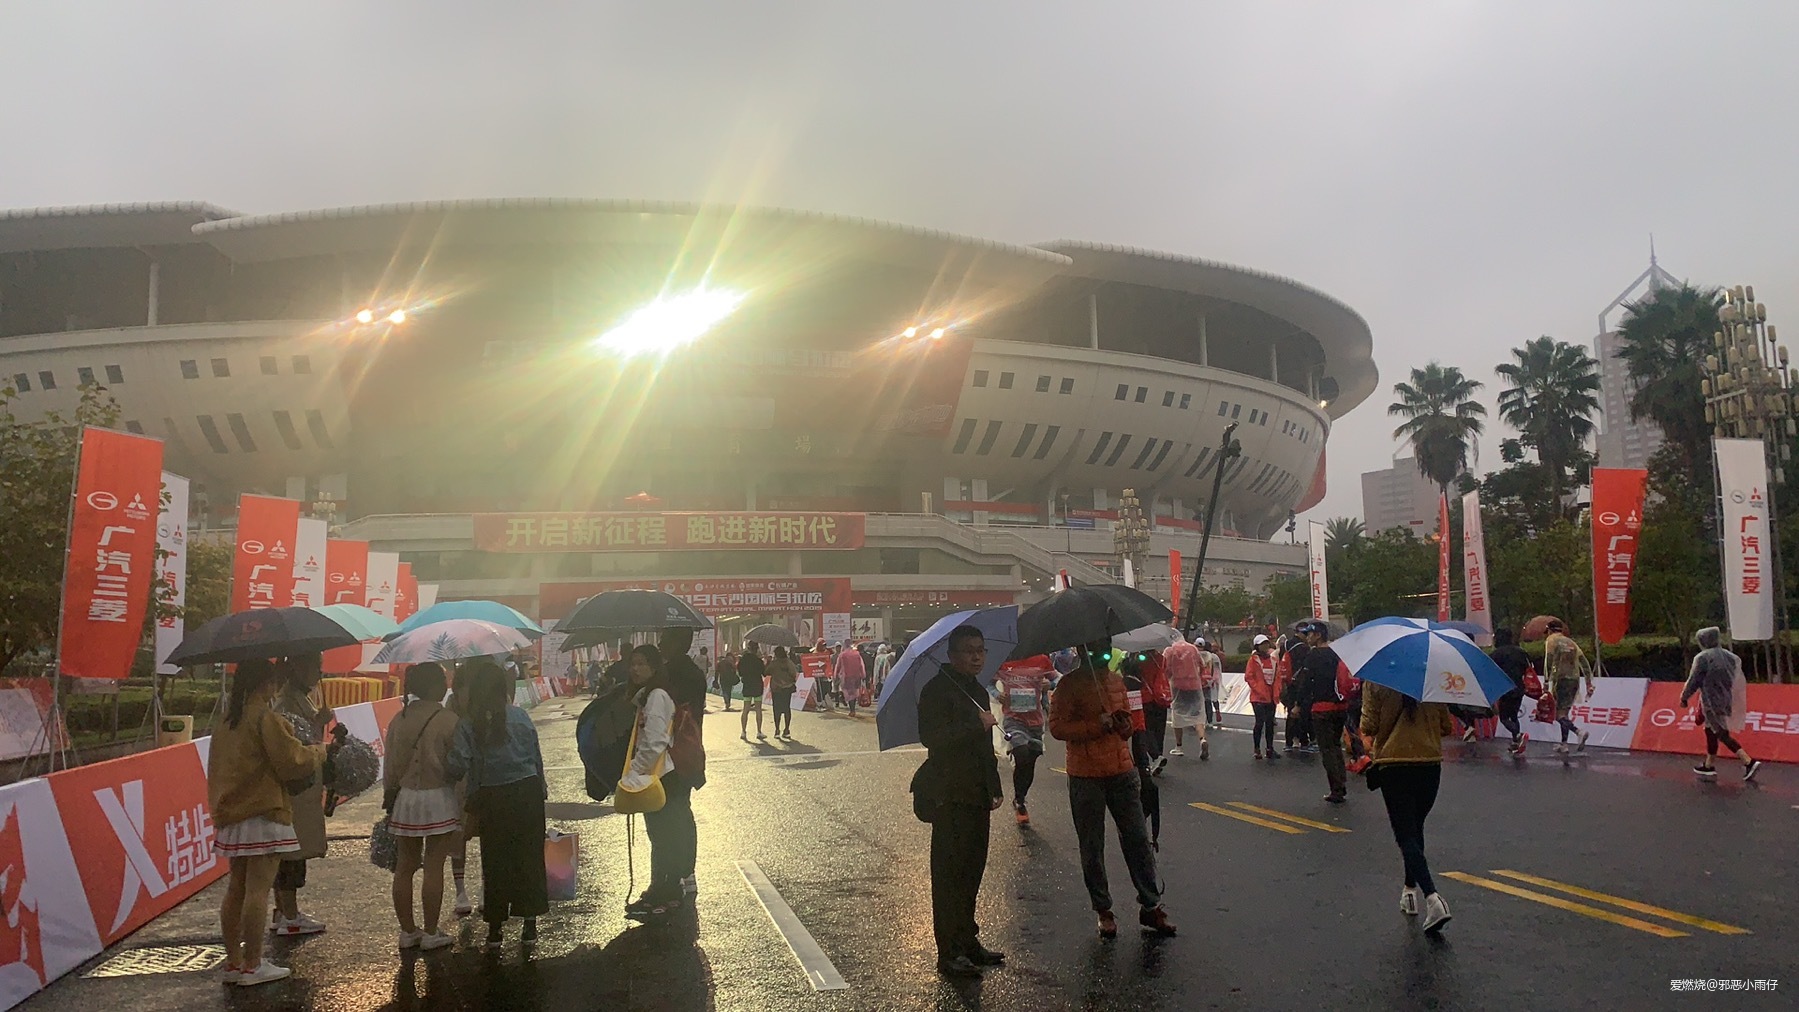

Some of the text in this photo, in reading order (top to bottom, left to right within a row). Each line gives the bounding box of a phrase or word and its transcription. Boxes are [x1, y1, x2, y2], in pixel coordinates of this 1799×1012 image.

[506, 516, 836, 547] 开启新征程 跑进新时代
[1740, 515, 1760, 594] 广汽三菱
[87, 526, 135, 622] 广汽三菱
[1607, 535, 1633, 604] 广汽三菱
[1440, 671, 1467, 691] 30
[165, 803, 217, 890] 特步
